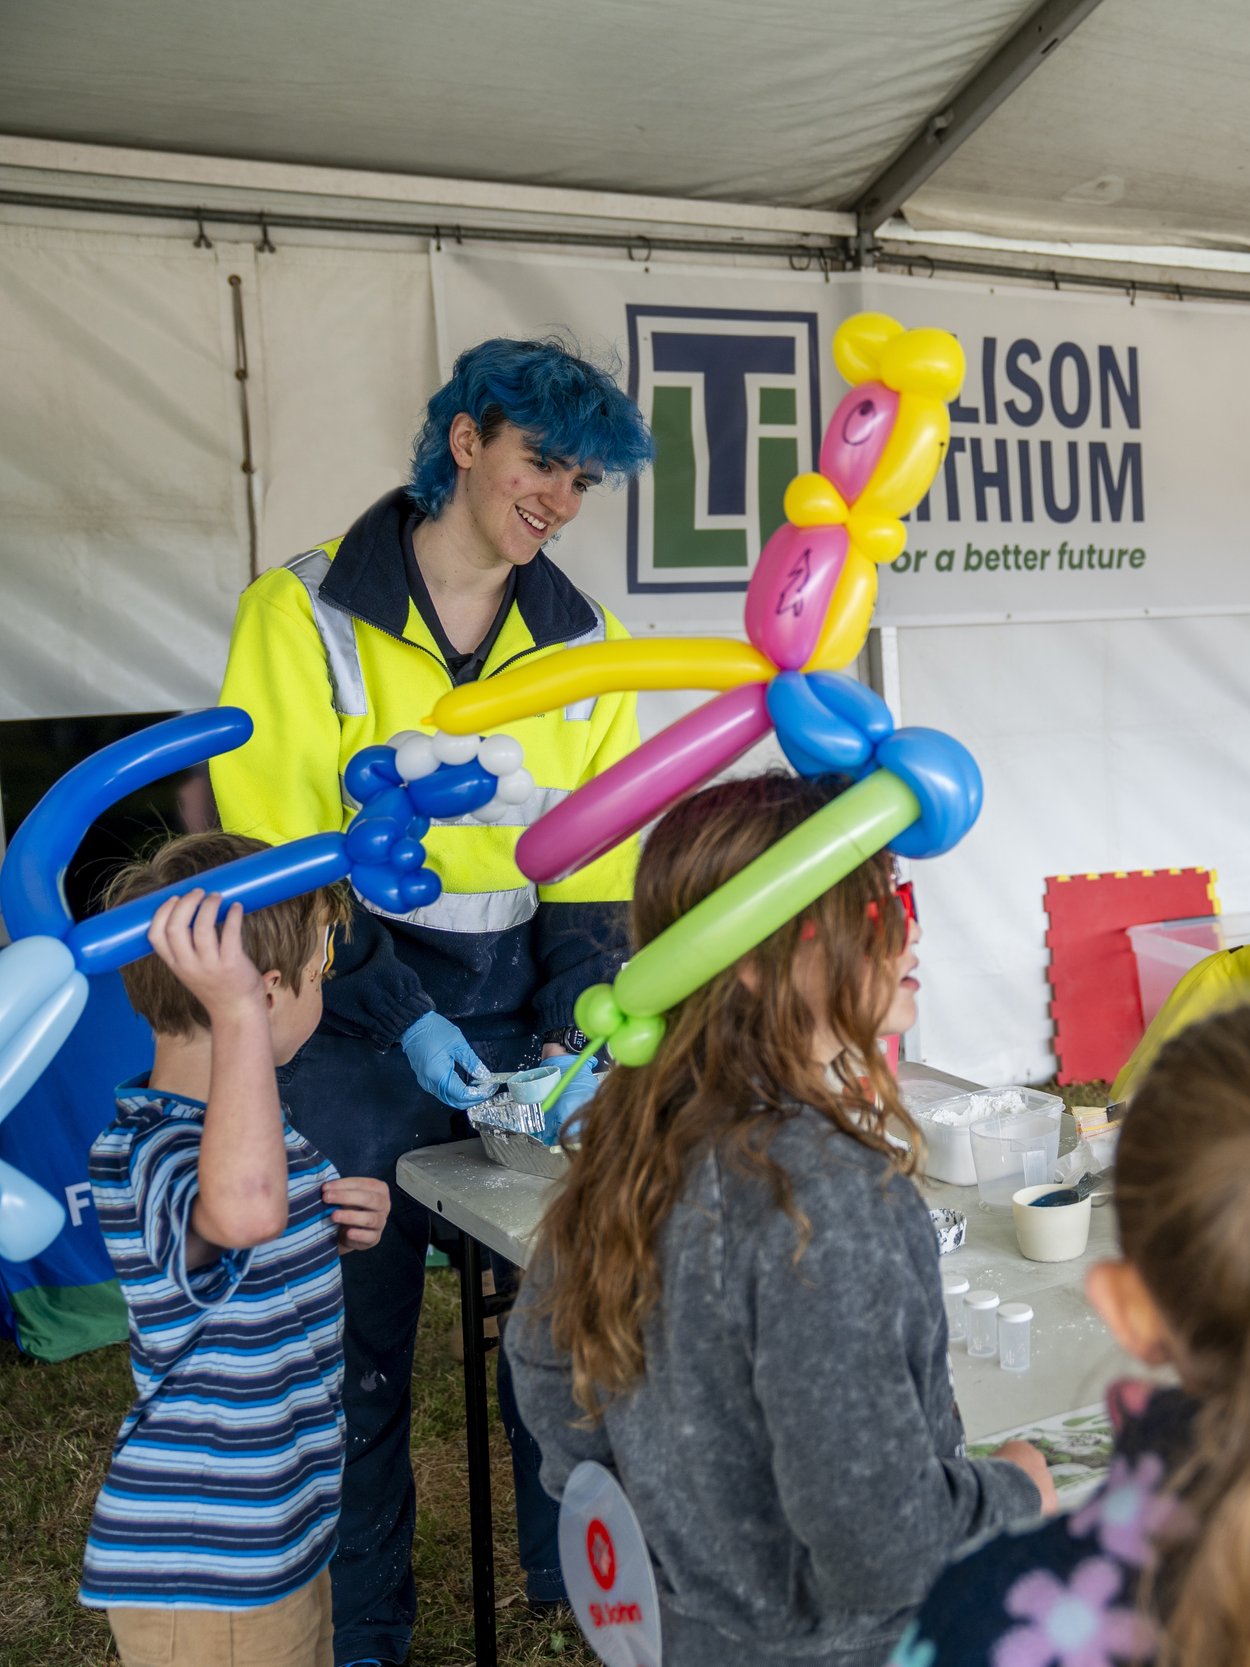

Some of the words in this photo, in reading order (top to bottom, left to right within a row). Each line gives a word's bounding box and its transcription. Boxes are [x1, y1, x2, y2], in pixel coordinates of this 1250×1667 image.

[946, 332, 1142, 431] LISON
[899, 435, 1145, 524] THIUM
[890, 549, 927, 573] or
[935, 549, 956, 573] a
[963, 542, 1052, 573] better
[1057, 541, 1147, 571] future
